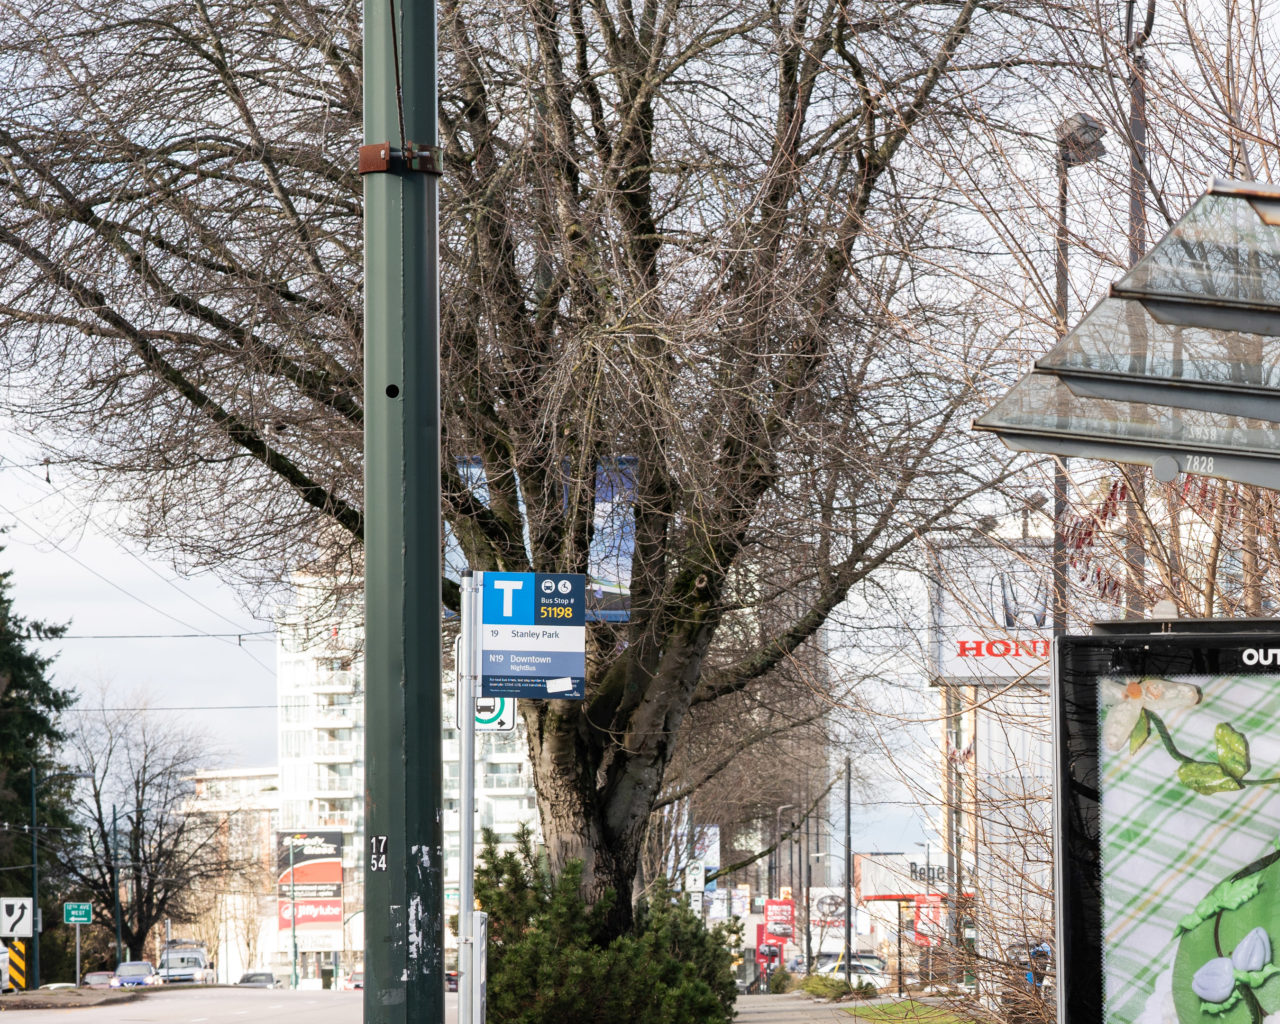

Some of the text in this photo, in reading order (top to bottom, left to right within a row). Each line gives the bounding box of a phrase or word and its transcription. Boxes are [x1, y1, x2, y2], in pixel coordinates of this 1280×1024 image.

[494, 580, 523, 617] T
[540, 607, 572, 618] 51198
[511, 630, 540, 640] Stanley
[542, 631, 560, 639] Park
[490, 654, 552, 663] N19 Downtown
[370, 836, 387, 853] 17
[370, 854, 387, 871] 54
